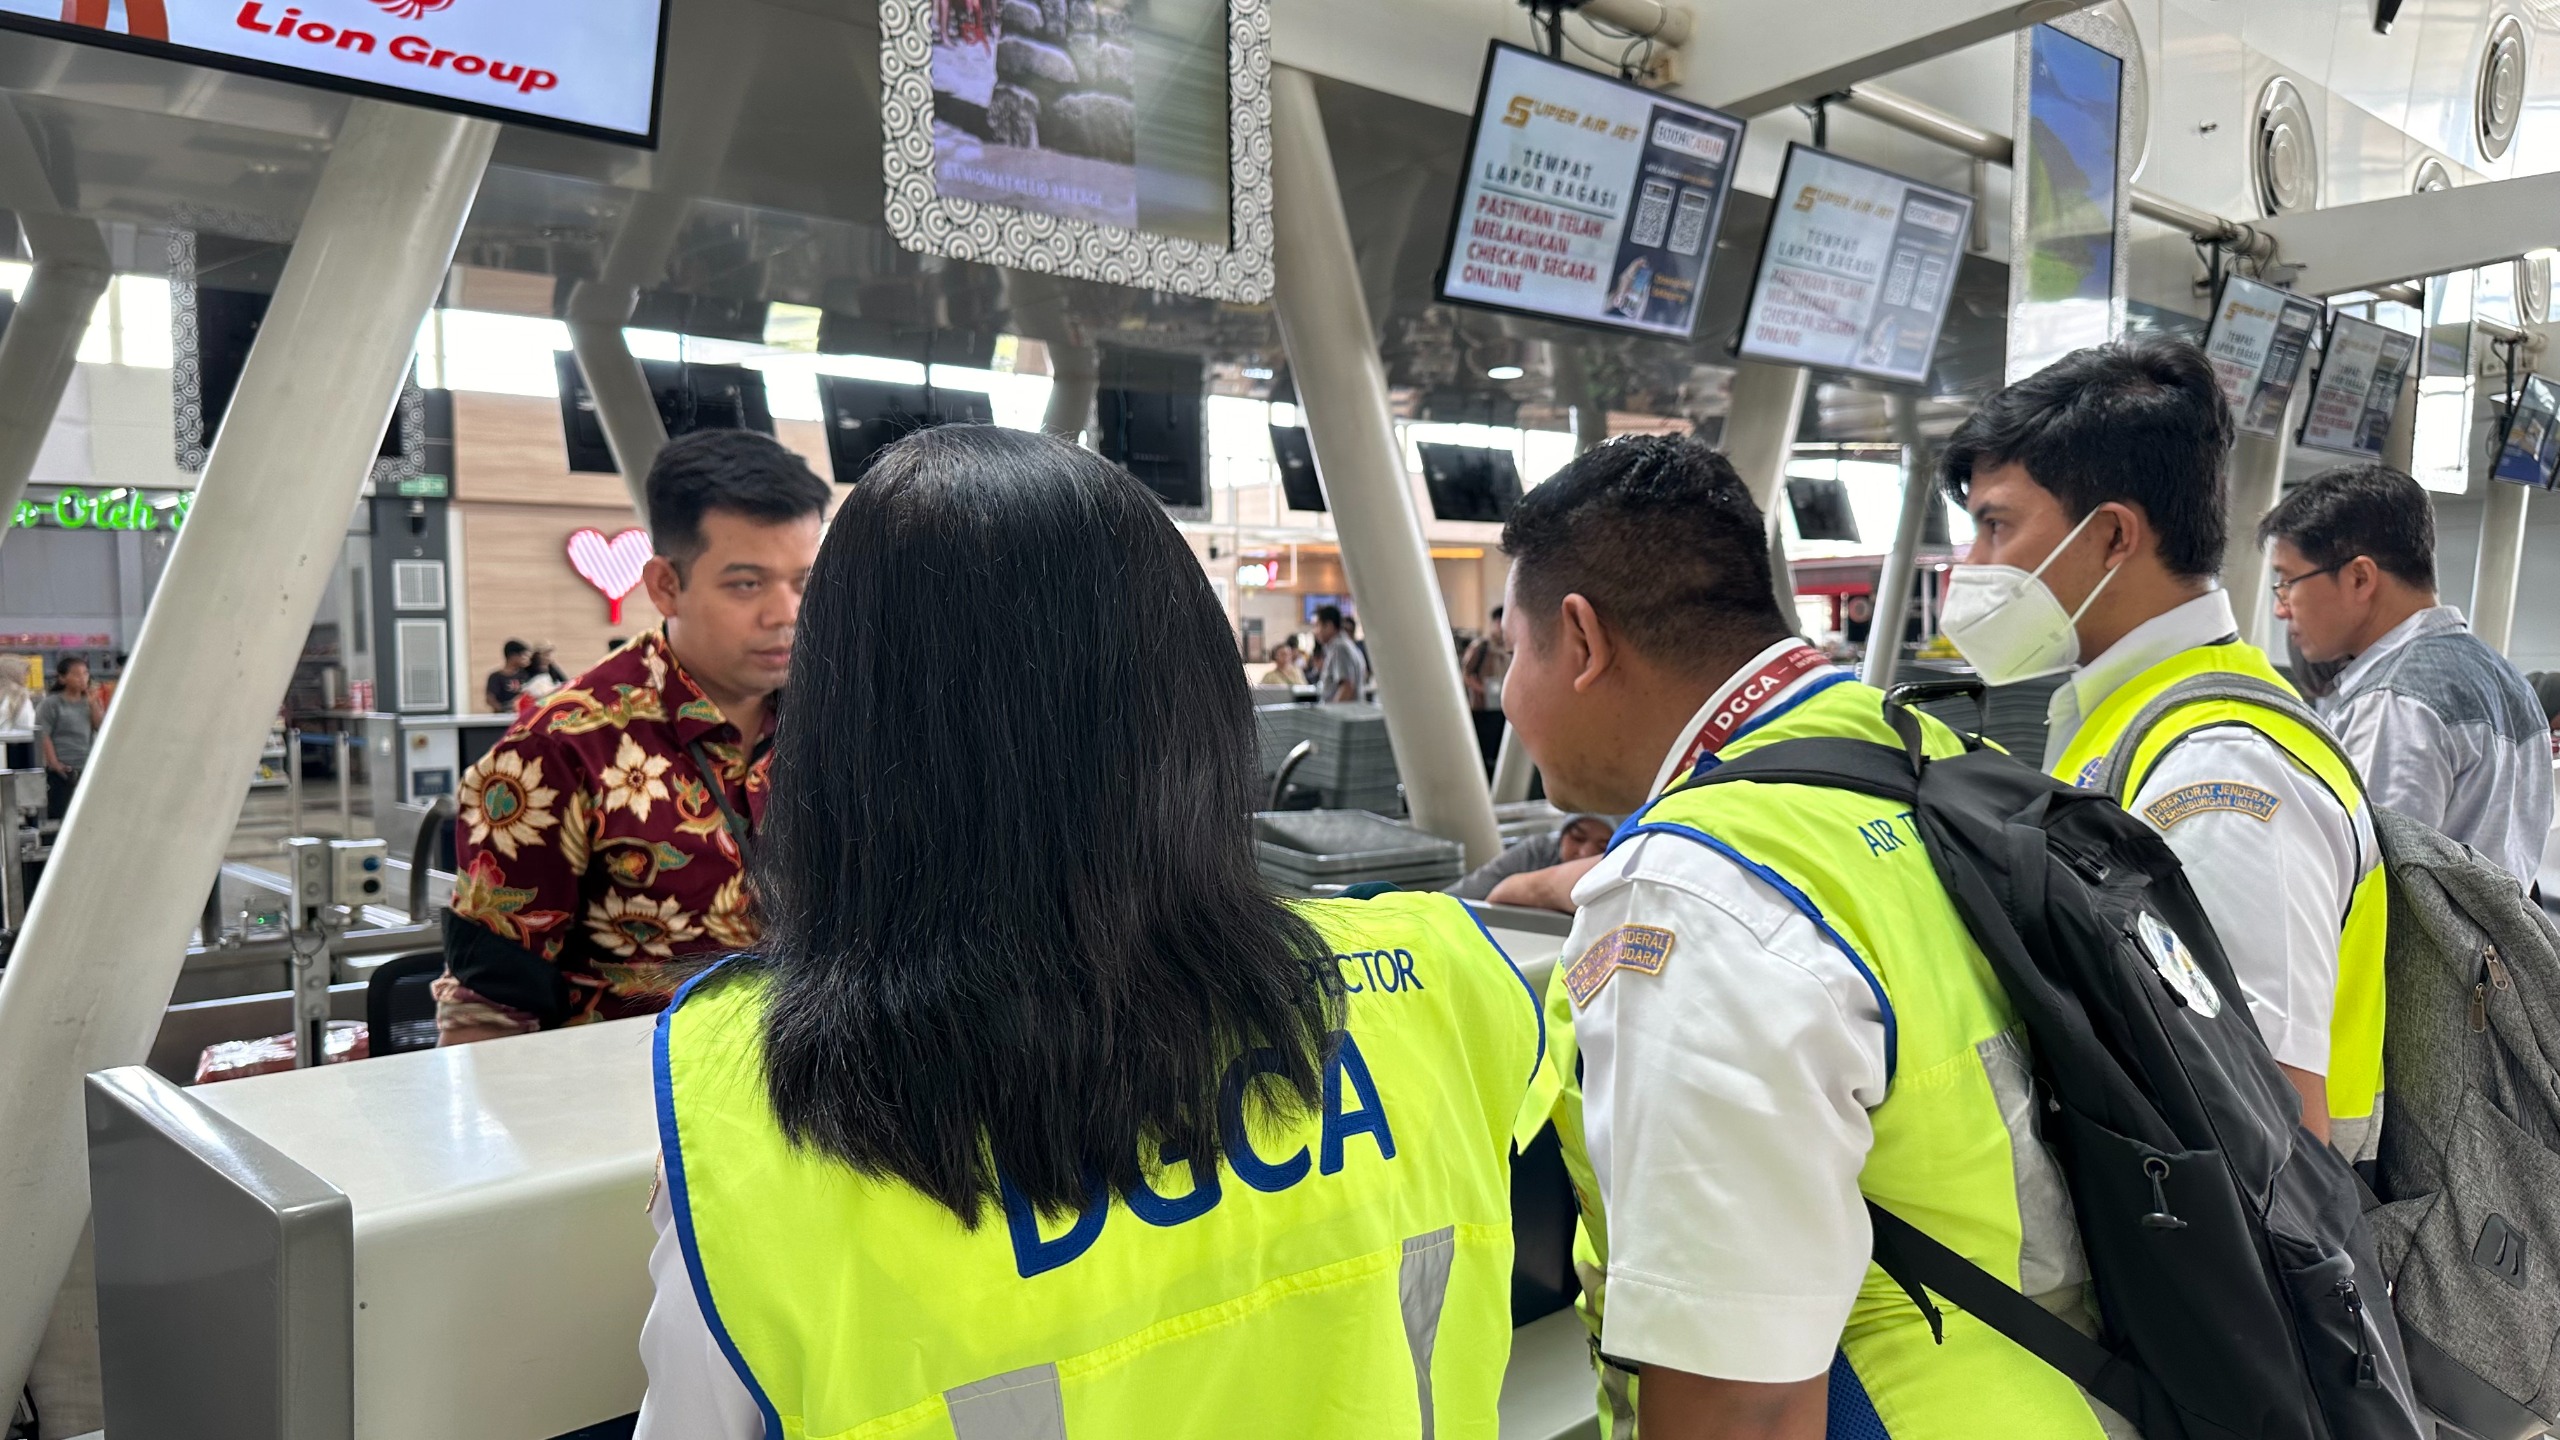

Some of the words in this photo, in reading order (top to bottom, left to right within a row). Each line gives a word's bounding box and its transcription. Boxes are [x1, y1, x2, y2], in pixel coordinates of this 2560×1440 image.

[236, 1, 377, 53] Lion
[389, 36, 560, 95] Group
[1502, 95, 1578, 129] SUPER
[1580, 114, 1610, 133] AIR
[1610, 123, 1641, 143] JET
[1523, 148, 1595, 180] TEMPAT
[1484, 161, 1545, 191] LAPOR
[1552, 179, 1617, 209] BAGASI
[1471, 218, 1571, 254] MELAKUKAN
[1475, 194, 1553, 227] PASTIKAN
[1556, 212, 1606, 239] TELAH
[1462, 264, 1524, 292] ONLINE
[1467, 241, 1538, 272] CHECK-IN
[1540, 255, 1597, 283] SECARA
[1714, 675, 1781, 731] DGCA
[2150, 785, 2215, 816] DIREKTORAT
[2216, 784, 2275, 809] JENDERAL
[2158, 795, 2231, 823] PERHUBUNGAN
[2233, 795, 2268, 815] UDARA
[1857, 819, 1907, 857] AIR
[1619, 945, 1660, 968] UDARA
[999, 1029, 1397, 1280] DGCA
